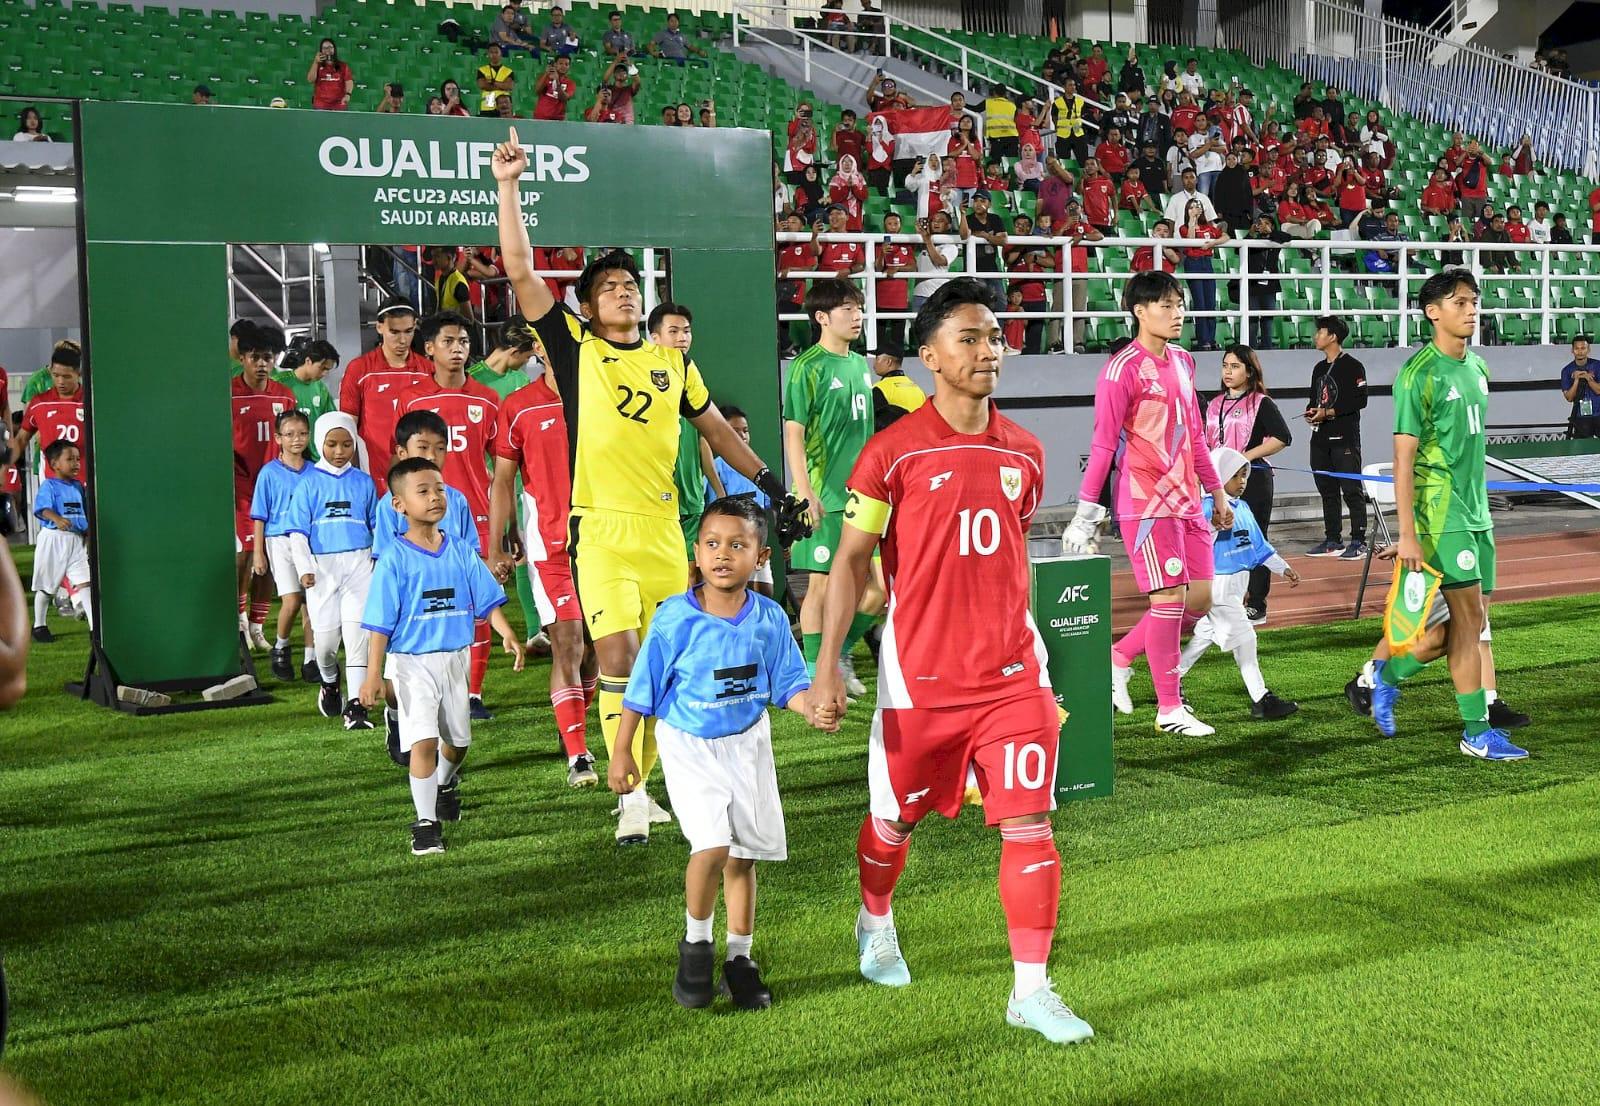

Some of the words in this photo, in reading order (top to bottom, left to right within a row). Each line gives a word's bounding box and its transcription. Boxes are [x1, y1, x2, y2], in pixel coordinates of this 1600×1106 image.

[318, 136, 590, 182] QUALIFERS
[374, 187, 410, 204] AFC
[413, 188, 446, 205] U23
[381, 209, 433, 226] SAUDI
[437, 210, 499, 226] ARABIA
[520, 212, 539, 227] 26
[616, 384, 653, 424] 22
[851, 393, 867, 421] 19
[1175, 397, 1183, 425] 1
[257, 421, 270, 441] 11
[1466, 403, 1481, 435] 11
[56, 424, 80, 443] 20
[446, 425, 468, 452] 15
[8, 468, 18, 484] 7
[844, 491, 860, 519] C
[959, 508, 1000, 556] 10
[1057, 584, 1090, 604] AFC
[1049, 614, 1099, 628] QUALIFIERS
[1003, 741, 1047, 790] 10
